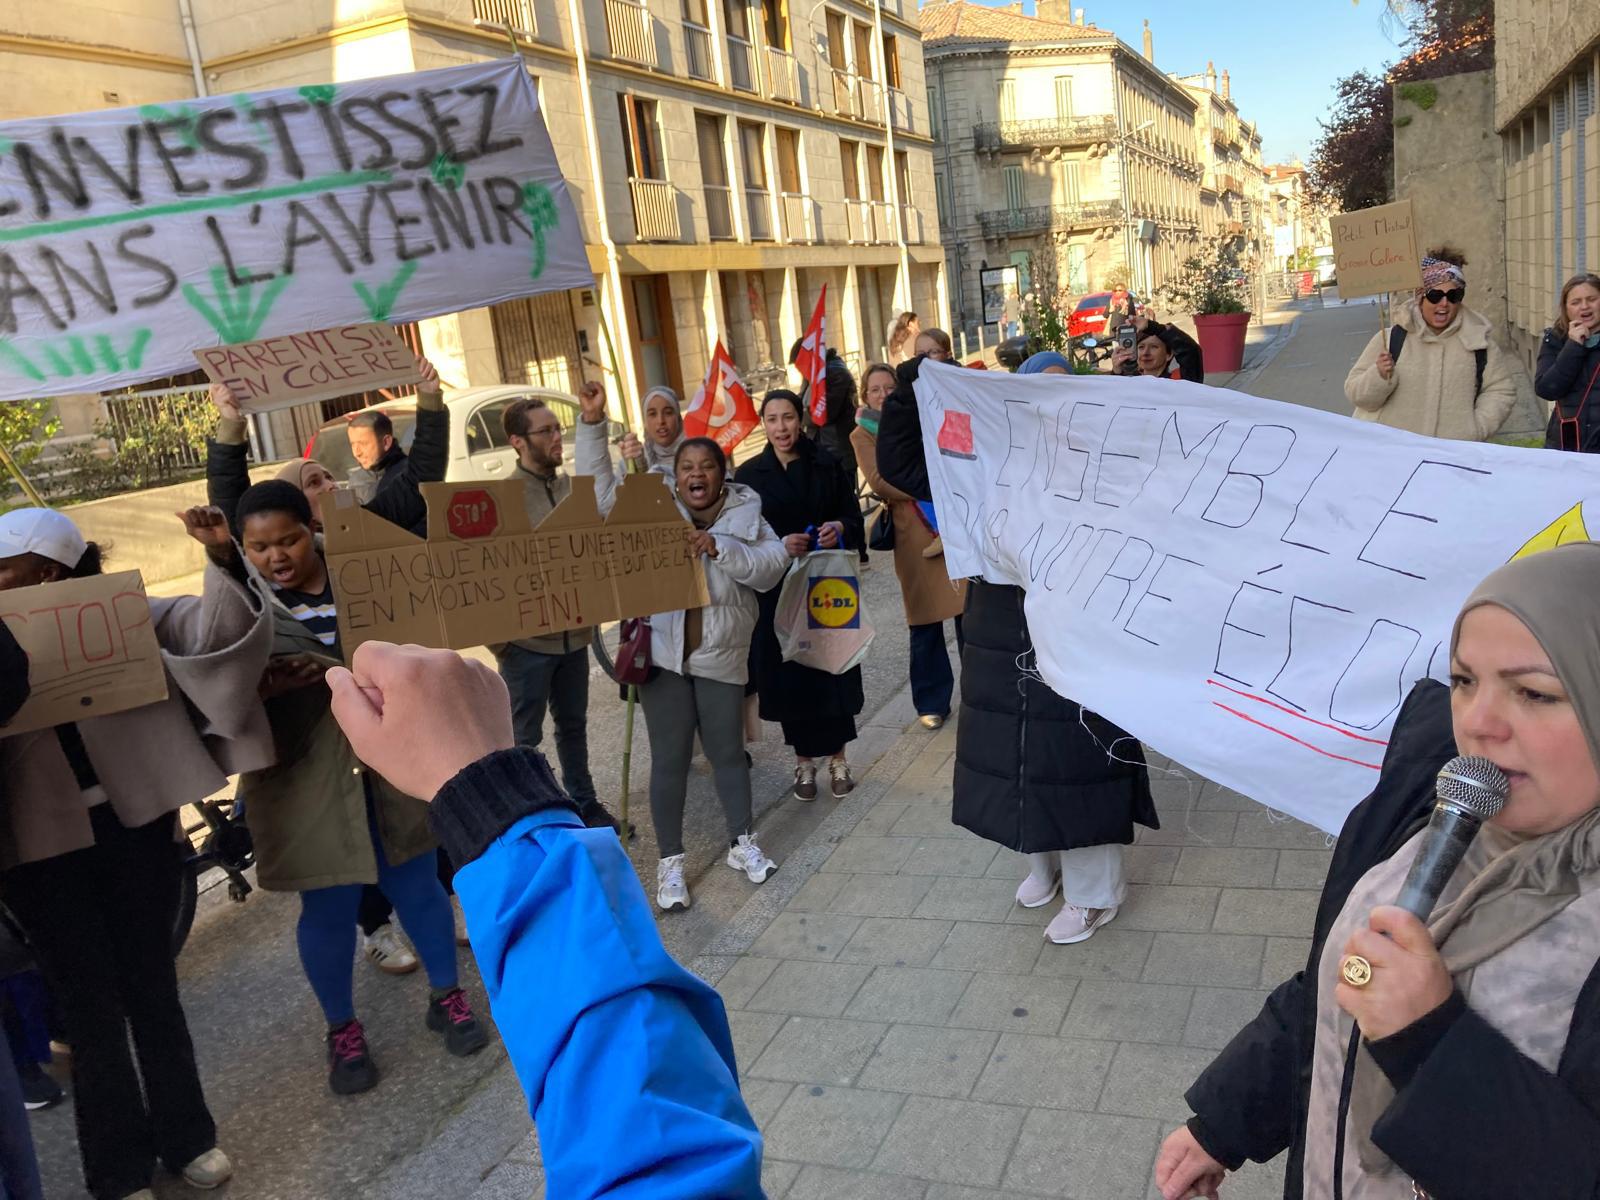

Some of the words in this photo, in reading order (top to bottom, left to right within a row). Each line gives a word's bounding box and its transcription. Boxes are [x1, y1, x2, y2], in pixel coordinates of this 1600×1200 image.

[0, 84, 524, 218] NVESTISSEZ
[0, 224, 179, 334] ANS
[206, 176, 534, 288] L'AVENIR
[222, 374, 270, 400] EN
[452, 501, 488, 528] STOP
[995, 399, 1492, 581] ENSEMBLE
[339, 546, 476, 597] CHAQUE
[347, 596, 395, 630] EN
[408, 577, 506, 618] MOINS
[562, 564, 583, 584] LE
[1018, 521, 1206, 647] NOTRE
[517, 587, 584, 632] FIN!
